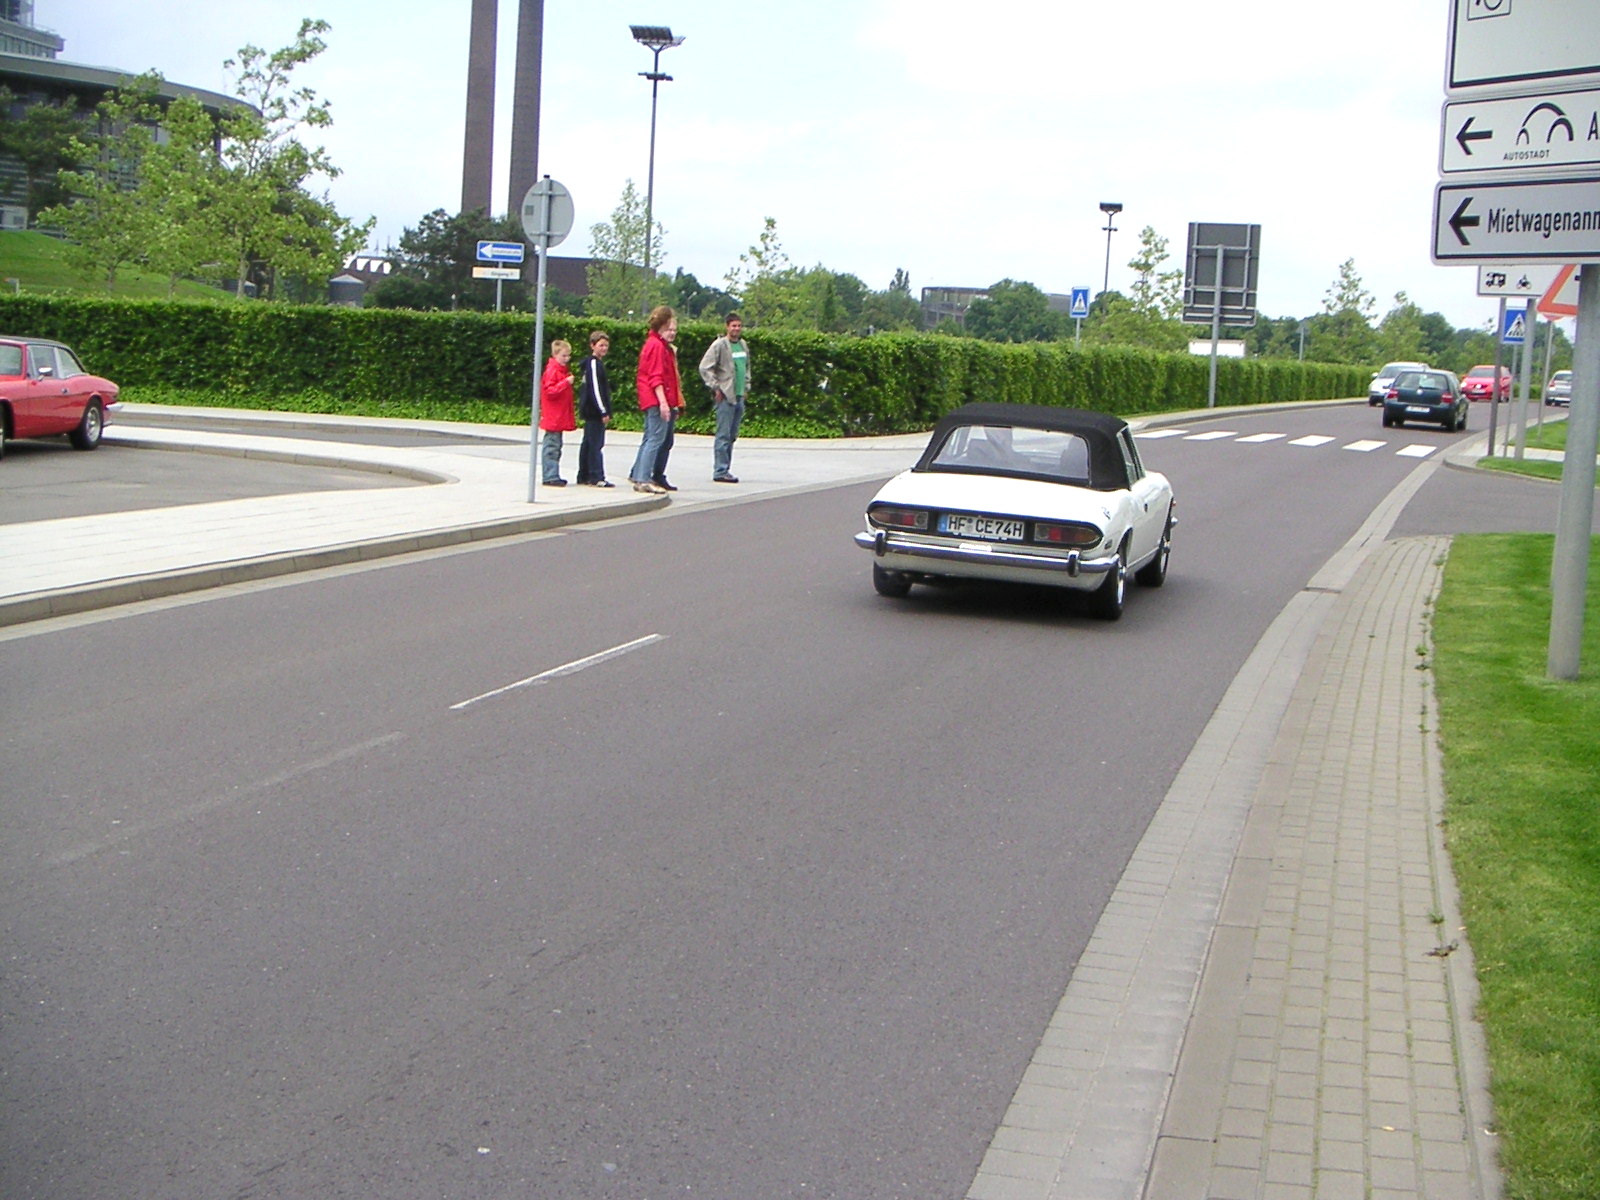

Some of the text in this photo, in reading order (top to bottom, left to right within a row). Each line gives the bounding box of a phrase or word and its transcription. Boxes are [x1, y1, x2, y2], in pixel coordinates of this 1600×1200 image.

[1502, 149, 1550, 161] AUTOSTADT
[1487, 207, 1600, 239] Mietwagenann
[948, 516, 968, 531] HF
